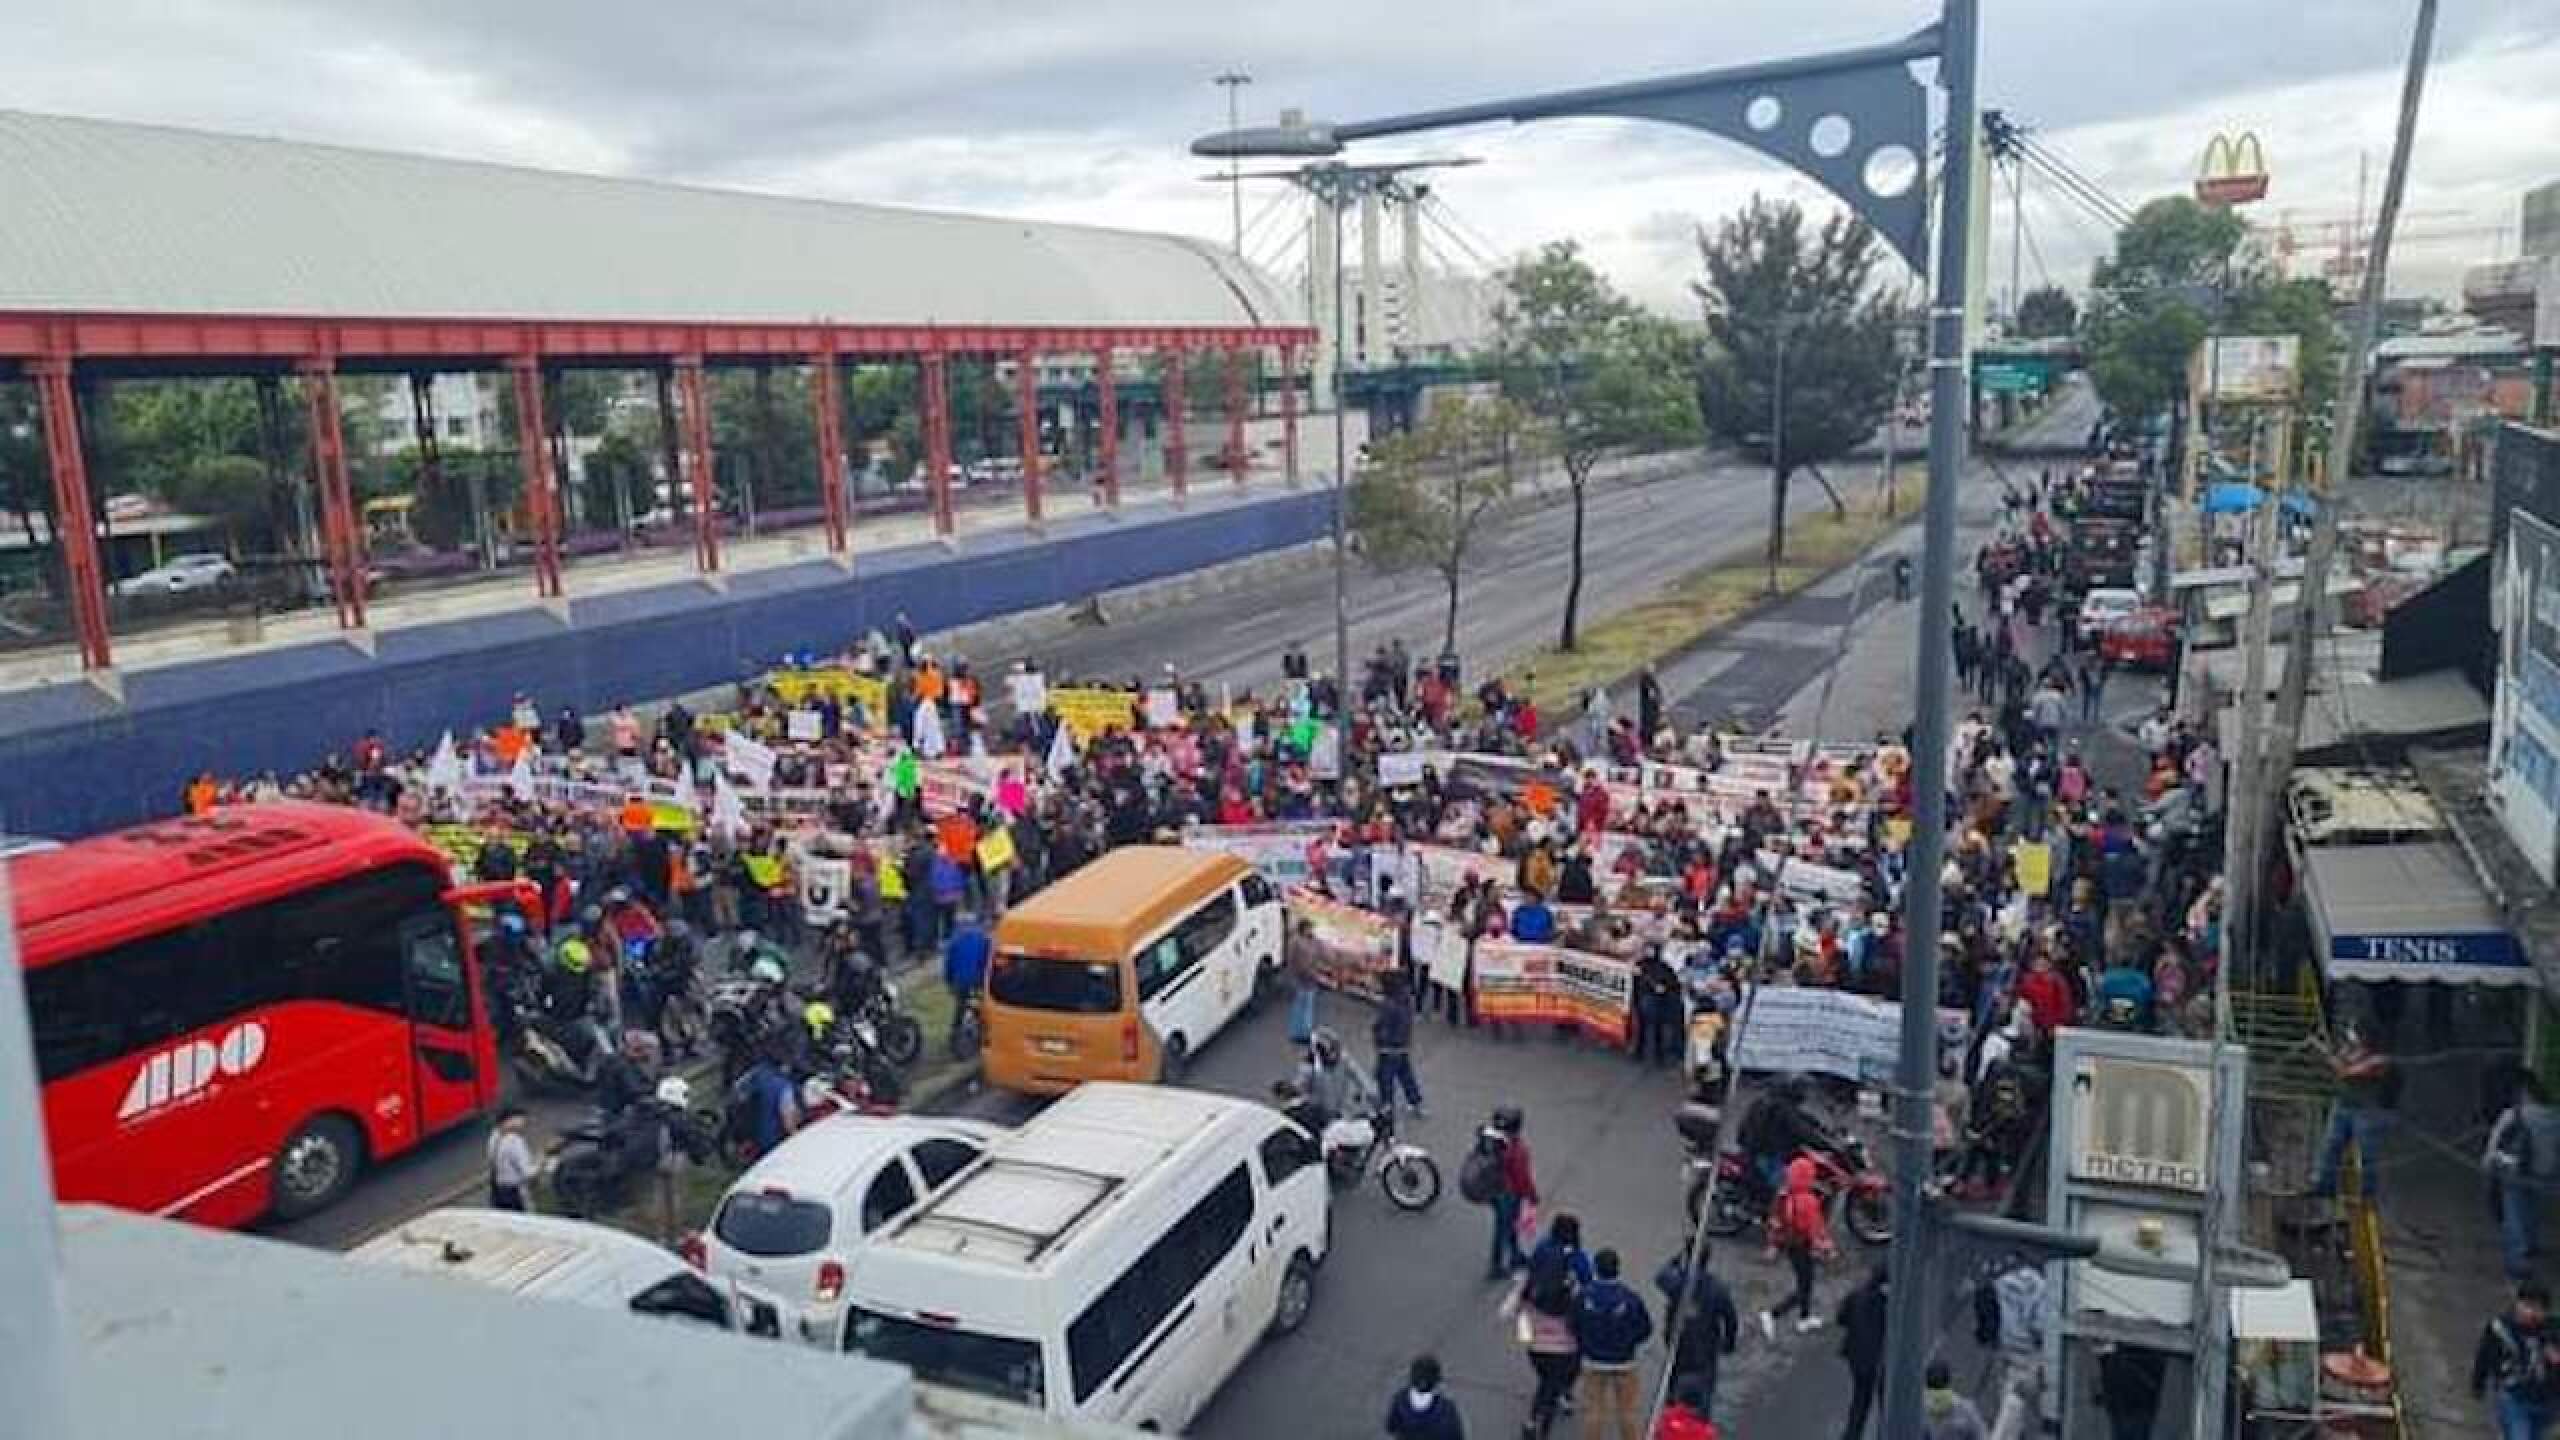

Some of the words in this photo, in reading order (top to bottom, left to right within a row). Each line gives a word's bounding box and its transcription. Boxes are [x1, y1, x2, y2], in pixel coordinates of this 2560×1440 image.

[2364, 937, 2458, 962] TENIS
[117, 1023, 266, 1119] ADO
[2087, 1155, 2198, 1185] METRO
